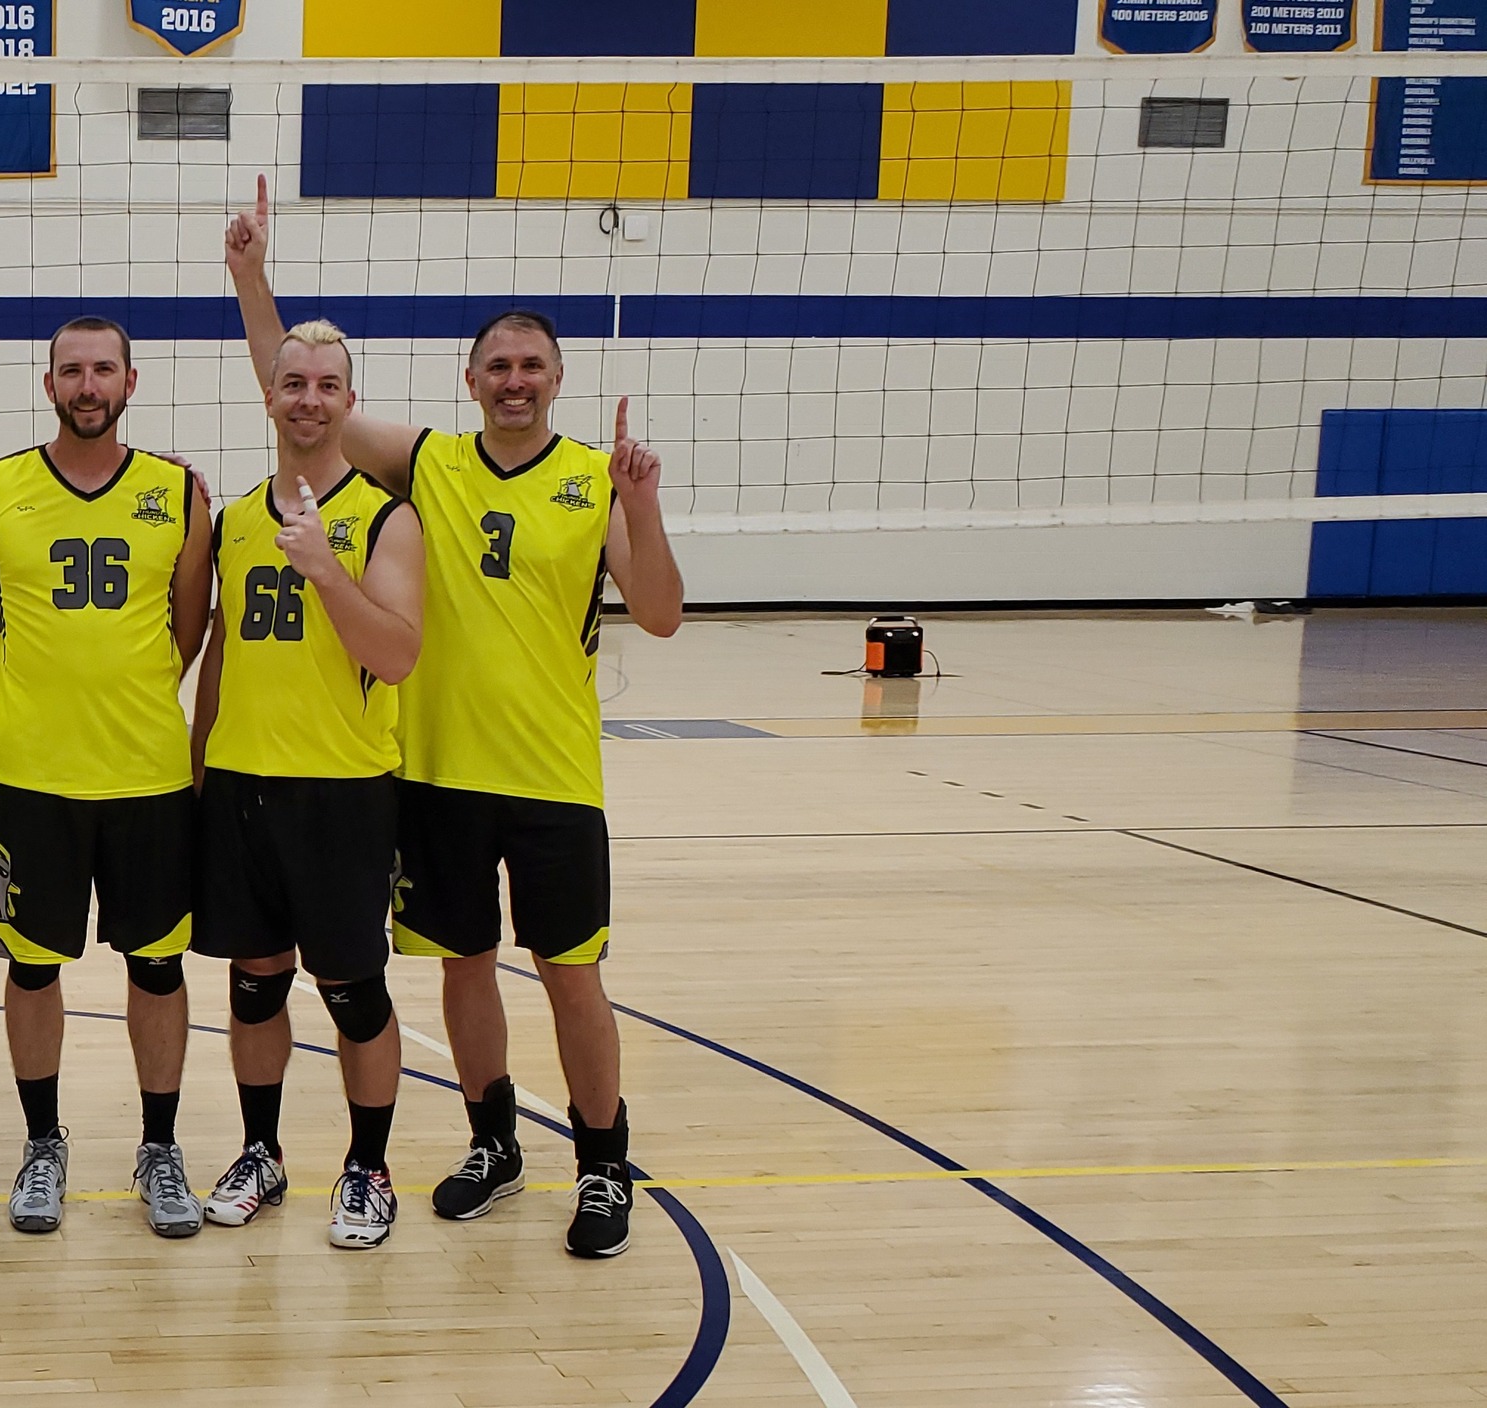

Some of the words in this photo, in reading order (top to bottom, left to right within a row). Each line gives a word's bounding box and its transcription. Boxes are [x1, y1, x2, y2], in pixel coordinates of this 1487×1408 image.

[161, 7, 216, 33] 2016
[1133, 10, 1177, 21] METERS
[1178, 10, 1209, 21] 2006
[1250, 6, 1270, 17] 200
[1272, 6, 1315, 18] METERS
[1316, 8, 1344, 19] 2010
[1249, 22, 1270, 34] 100
[1271, 23, 1314, 35] METERS
[1315, 24, 1342, 35] 2011
[479, 511, 516, 580] 3
[49, 538, 131, 610] 36
[240, 565, 305, 641] 66
